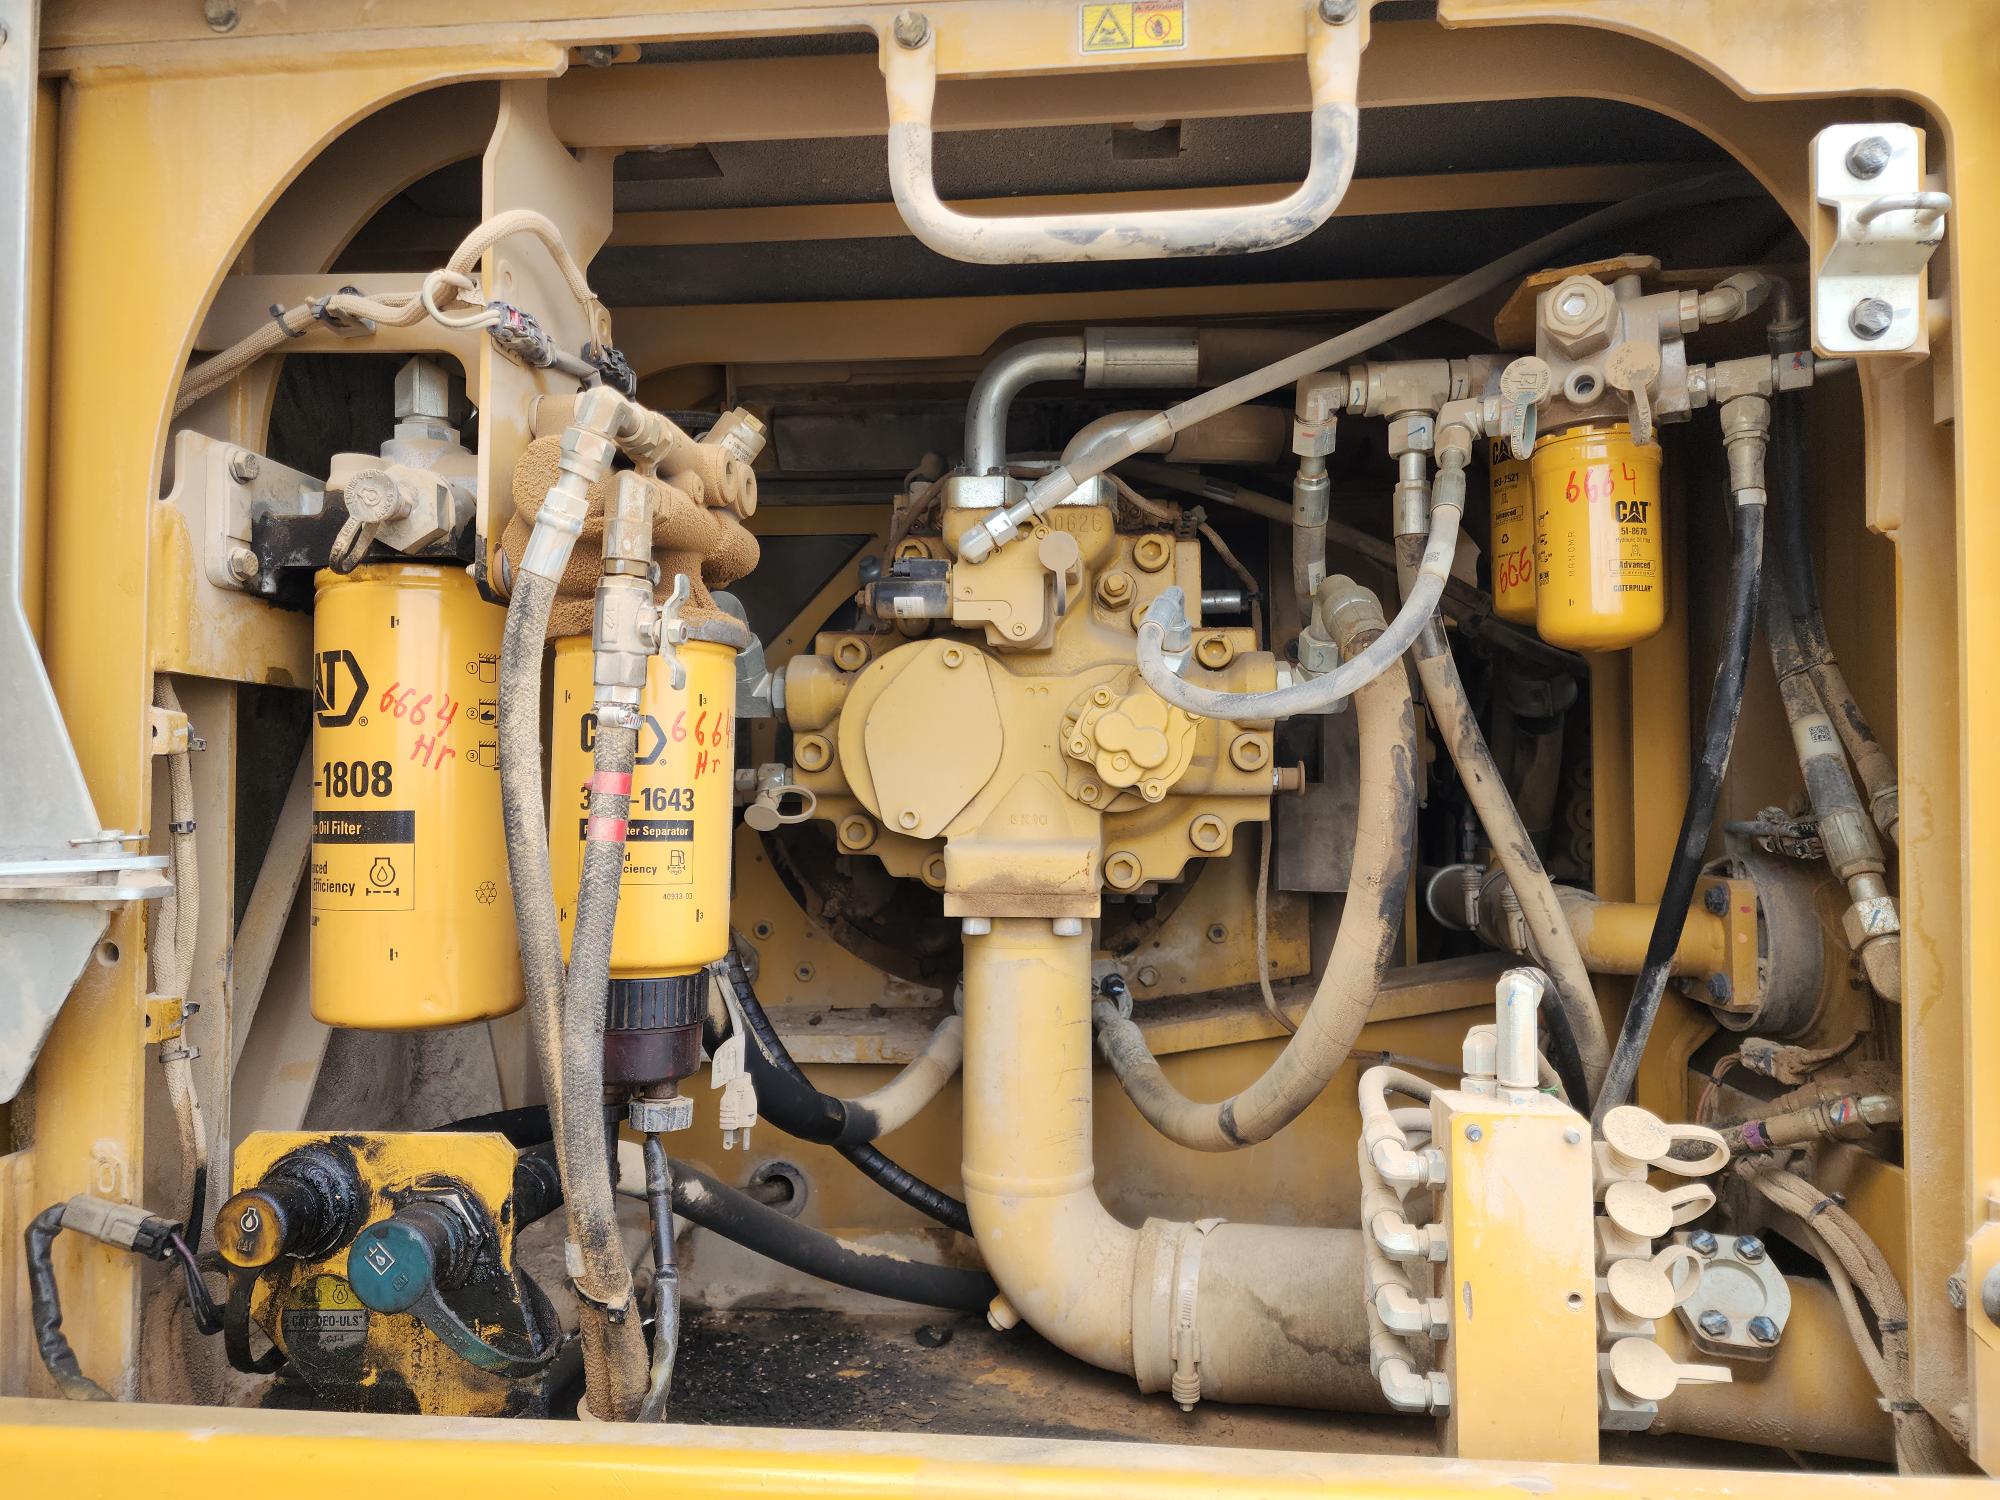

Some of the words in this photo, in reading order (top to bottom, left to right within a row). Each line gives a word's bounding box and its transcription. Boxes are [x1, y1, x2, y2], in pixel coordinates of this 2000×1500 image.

[1493, 440, 1512, 465] CA
[1566, 462, 1637, 502] 6664
[1615, 501, 1649, 523] CAT
[1619, 561, 1651, 569] Advanced
[1613, 584, 1651, 592] CATERPILLAR
[379, 682, 459, 737] 6664
[410, 734, 456, 770] Hr
[694, 750, 720, 780] Hr
[318, 822, 330, 835] Oil
[331, 822, 362, 835] Filter
[642, 826, 689, 838] Separator
[623, 864, 658, 876] ciency
